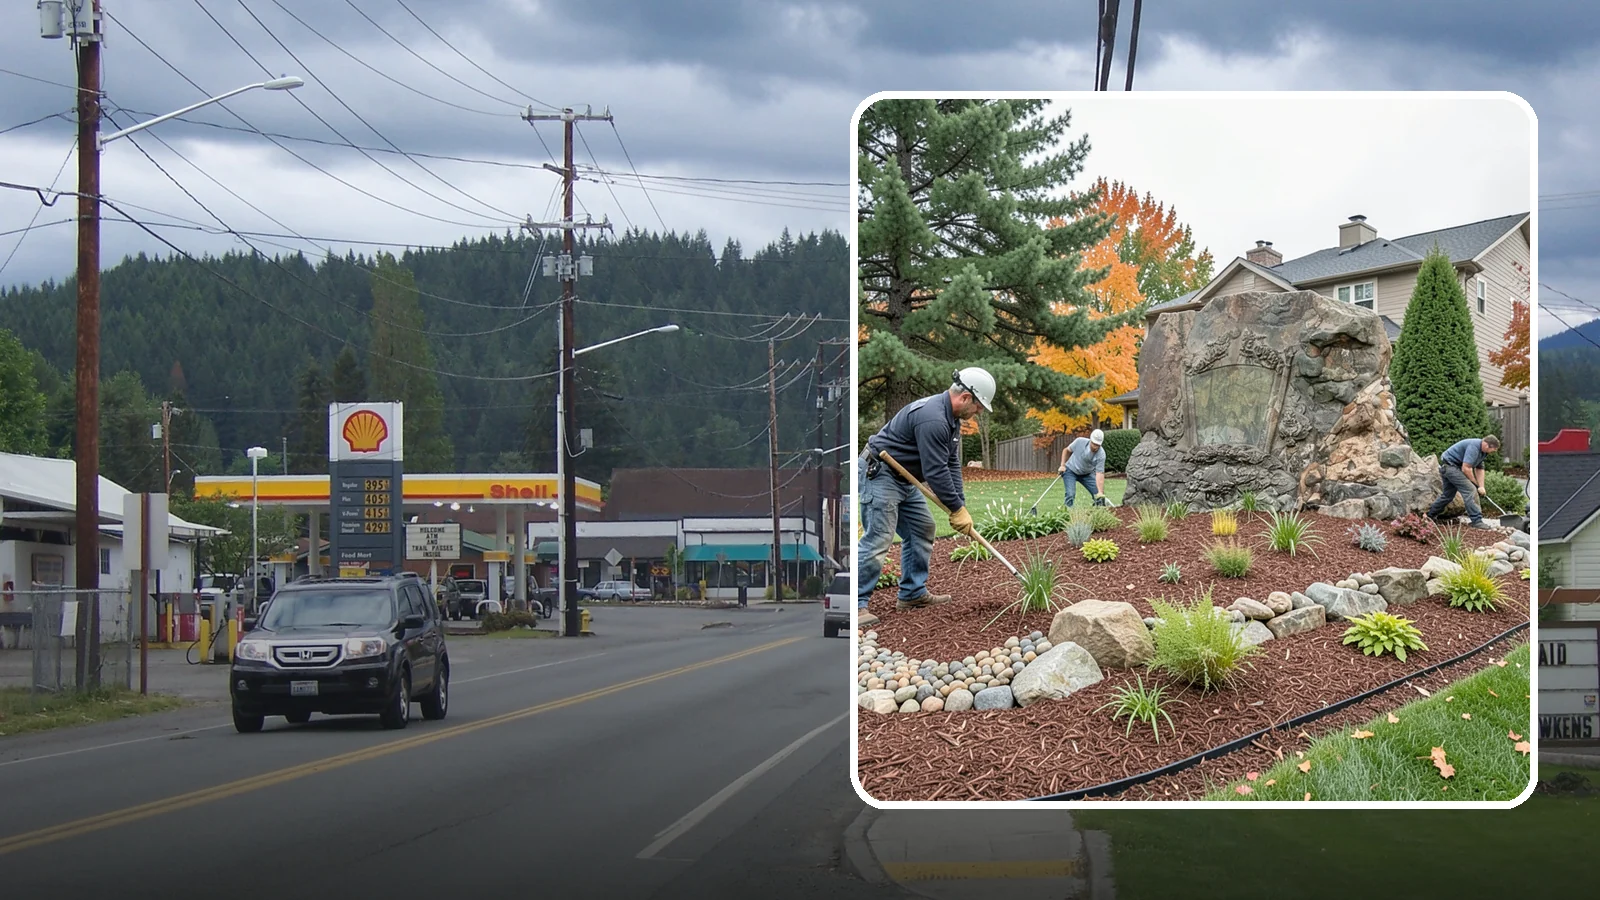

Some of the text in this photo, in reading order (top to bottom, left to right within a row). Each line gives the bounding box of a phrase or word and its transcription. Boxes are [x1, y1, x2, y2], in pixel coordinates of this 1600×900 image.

[366, 480, 383, 490] 395
[490, 484, 547, 499] Shell
[366, 494, 383, 504] 405
[366, 508, 383, 518] 415
[366, 522, 383, 532] 429
[1538, 642, 1566, 666] AID
